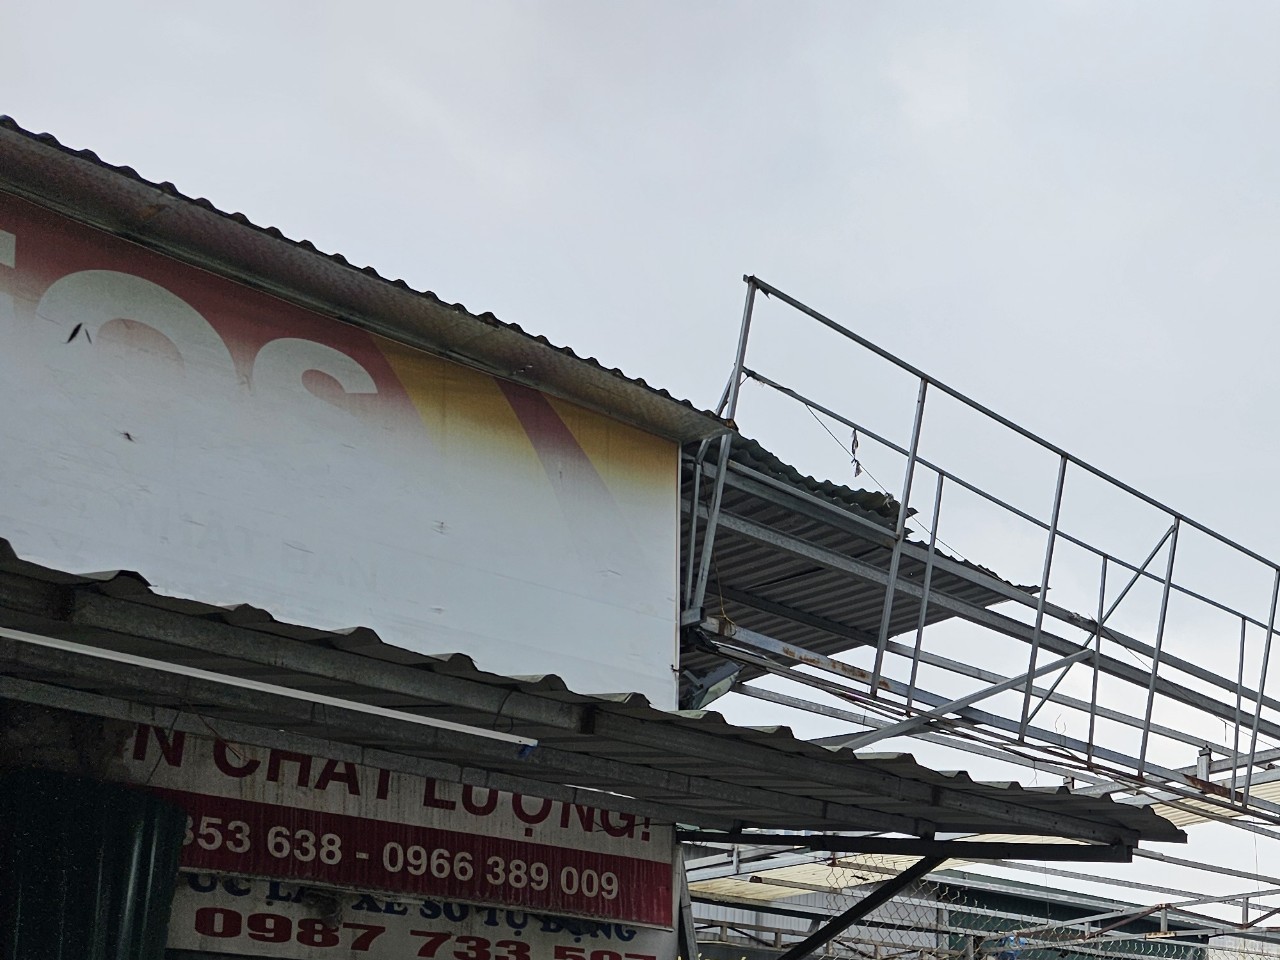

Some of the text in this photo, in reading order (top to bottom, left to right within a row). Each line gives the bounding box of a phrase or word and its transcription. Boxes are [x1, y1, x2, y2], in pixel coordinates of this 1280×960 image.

[267, 826, 342, 865] 638
[382, 841, 474, 883] 0966
[486, 856, 550, 891] 389
[561, 864, 619, 900] 009
[194, 907, 385, 951] 0987
